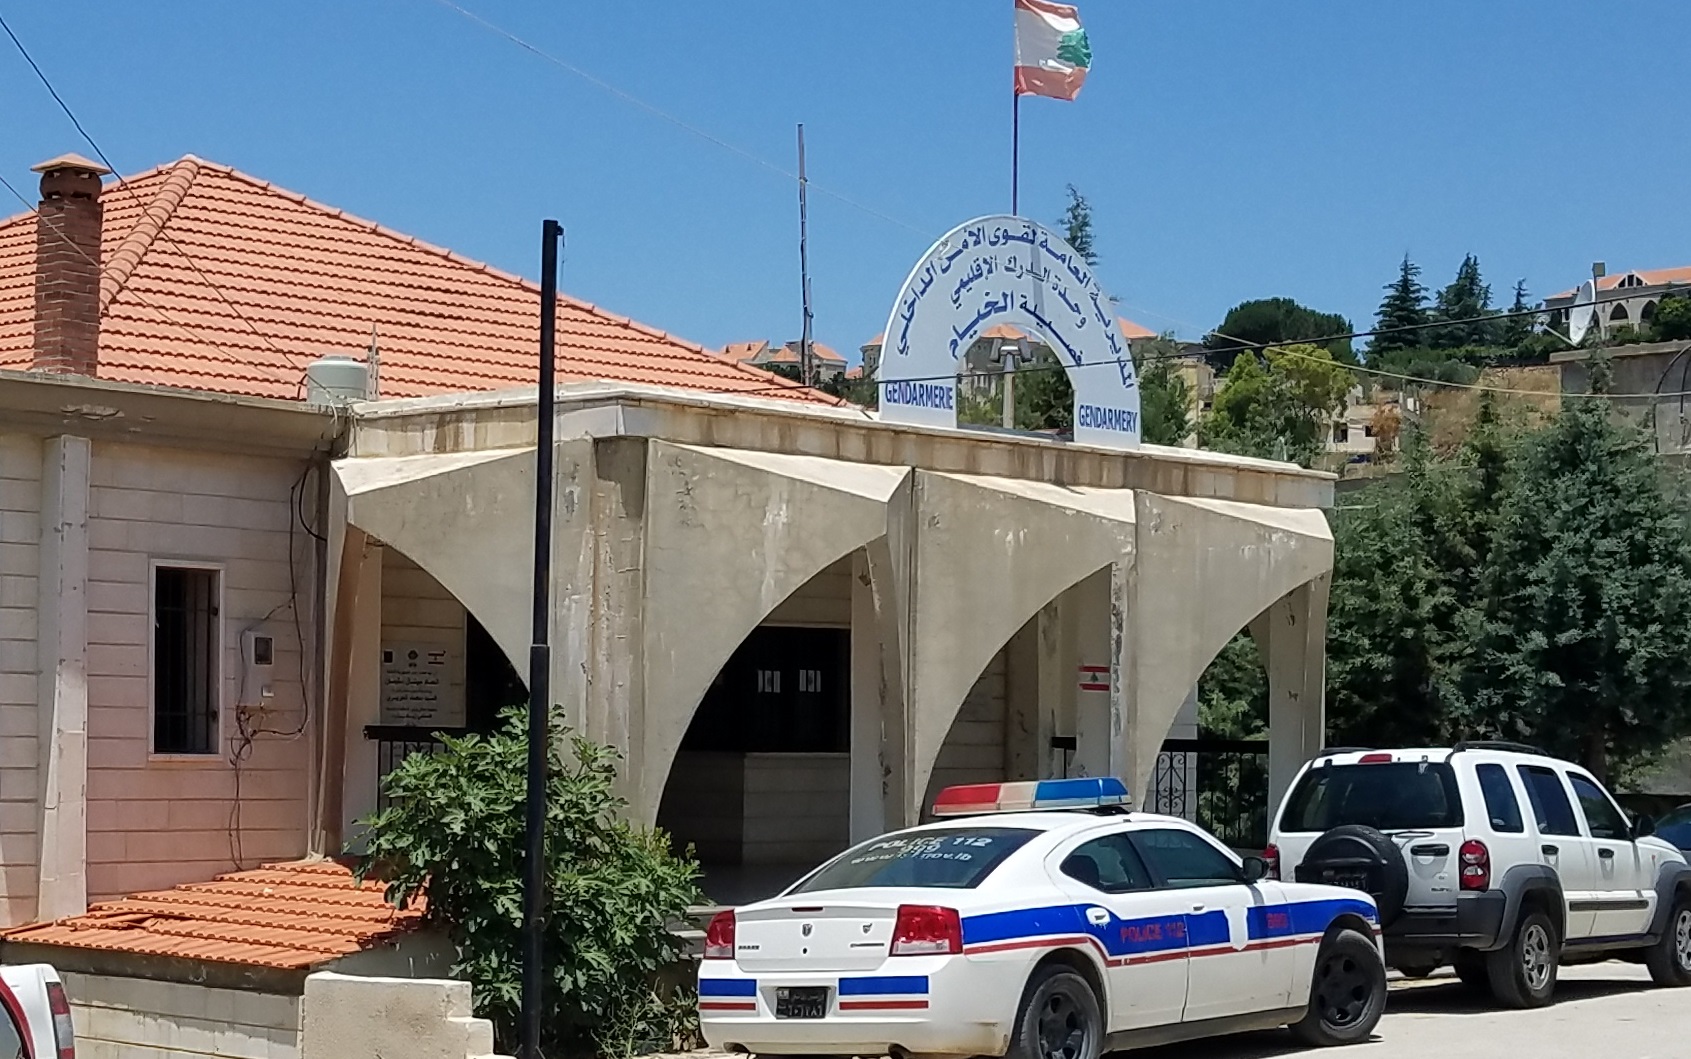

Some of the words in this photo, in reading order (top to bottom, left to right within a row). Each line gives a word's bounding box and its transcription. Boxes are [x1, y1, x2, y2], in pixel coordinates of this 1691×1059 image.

[987, 224, 1038, 247] لقوى
[1003, 255, 1052, 284] الدرك
[1039, 230, 1091, 288] العامة
[896, 260, 937, 357] الداخلي
[1052, 274, 1087, 328] وحدة
[949, 289, 1015, 360] الخيام
[1019, 294, 1084, 368] فصيلة
[884, 382, 954, 411] GENDARMERIE
[1078, 404, 1138, 434] GENDARMERY
[868, 836, 948, 852] POLICE
[953, 837, 994, 848] 112
[1120, 922, 1163, 943] POLICE
